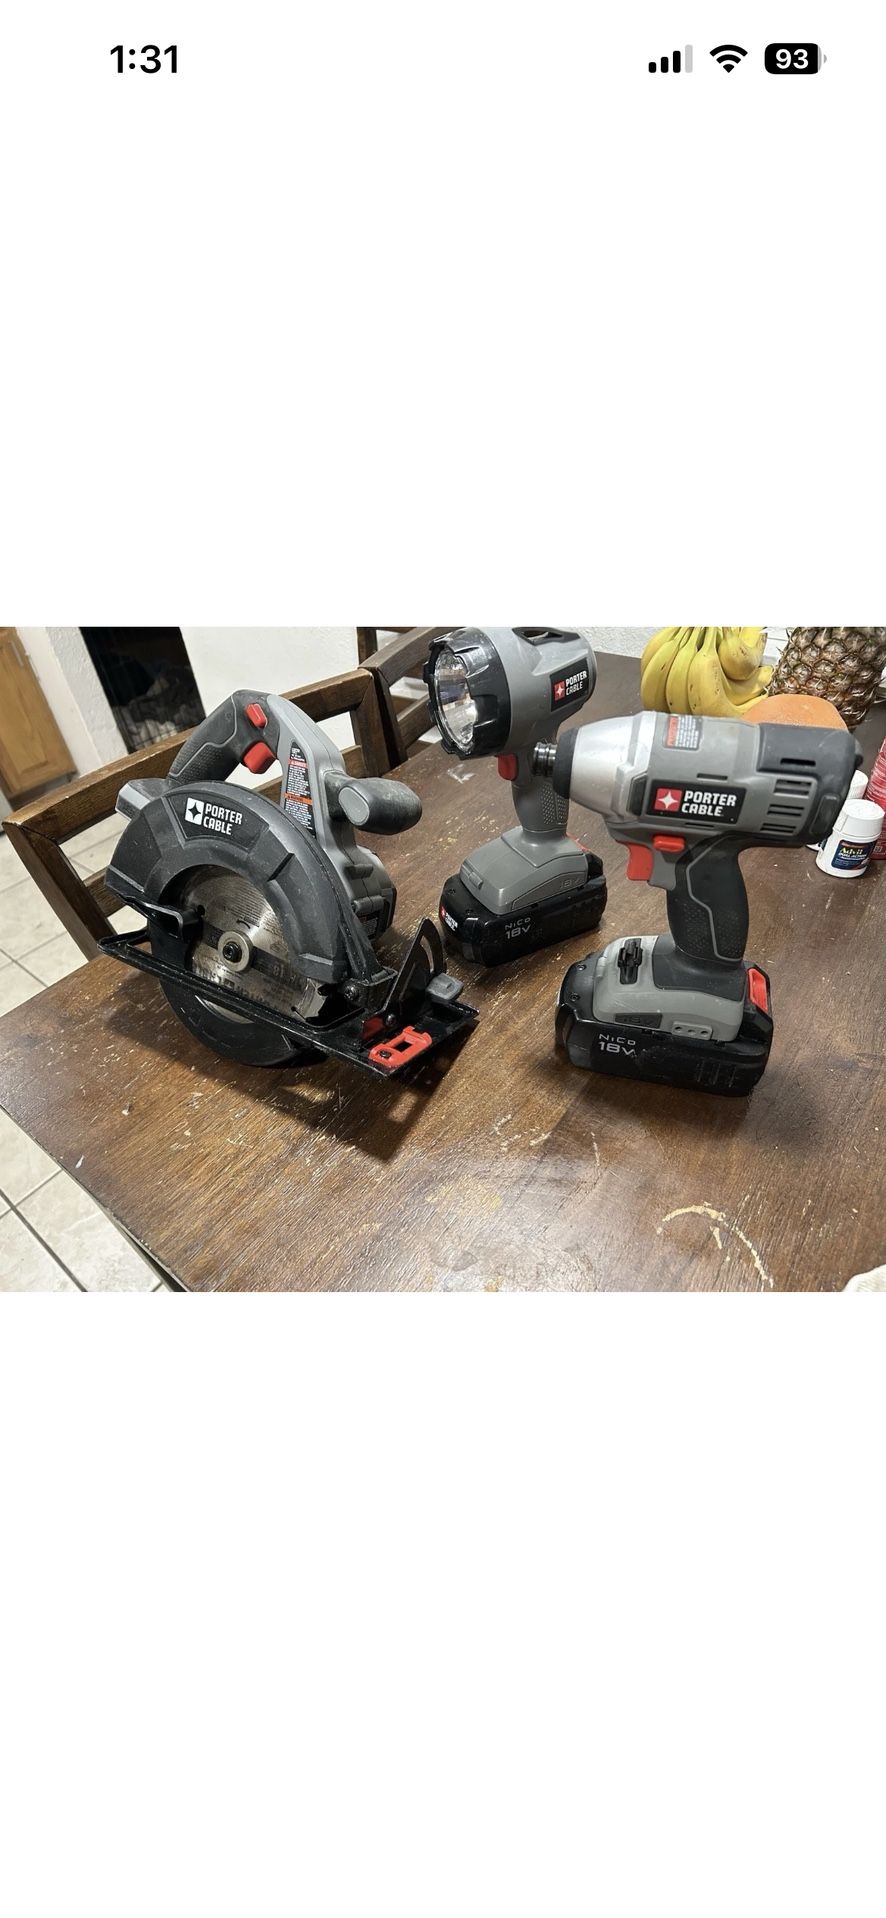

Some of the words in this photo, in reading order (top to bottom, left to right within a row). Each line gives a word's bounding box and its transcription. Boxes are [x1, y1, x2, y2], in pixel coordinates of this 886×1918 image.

[565, 670, 587, 687] PORTER
[565, 681, 583, 696] CABLE
[684, 790, 738, 807] PORTER
[205, 803, 243, 825] PORTER
[681, 803, 723, 817] CABLE
[203, 816, 233, 836] CABLE
[840, 847, 863, 855] Advil
[505, 924, 531, 940] 18V
[598, 1042, 636, 1056] 18V
